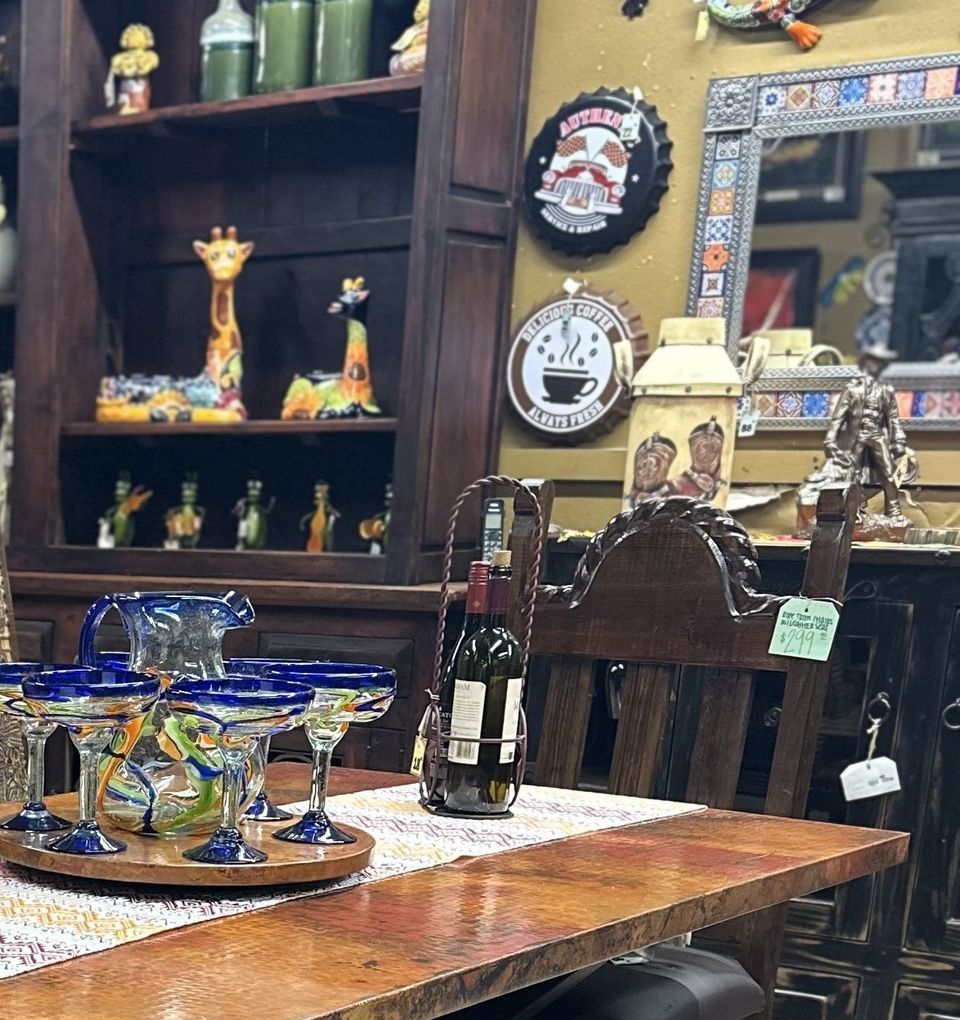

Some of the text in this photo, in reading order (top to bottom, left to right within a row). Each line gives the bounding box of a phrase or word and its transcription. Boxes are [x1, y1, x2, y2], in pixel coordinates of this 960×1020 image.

[576, 220, 607, 234] REPAIR
[576, 304, 614, 333] COFFEE
[527, 399, 604, 428] ALWAYS FRESH
